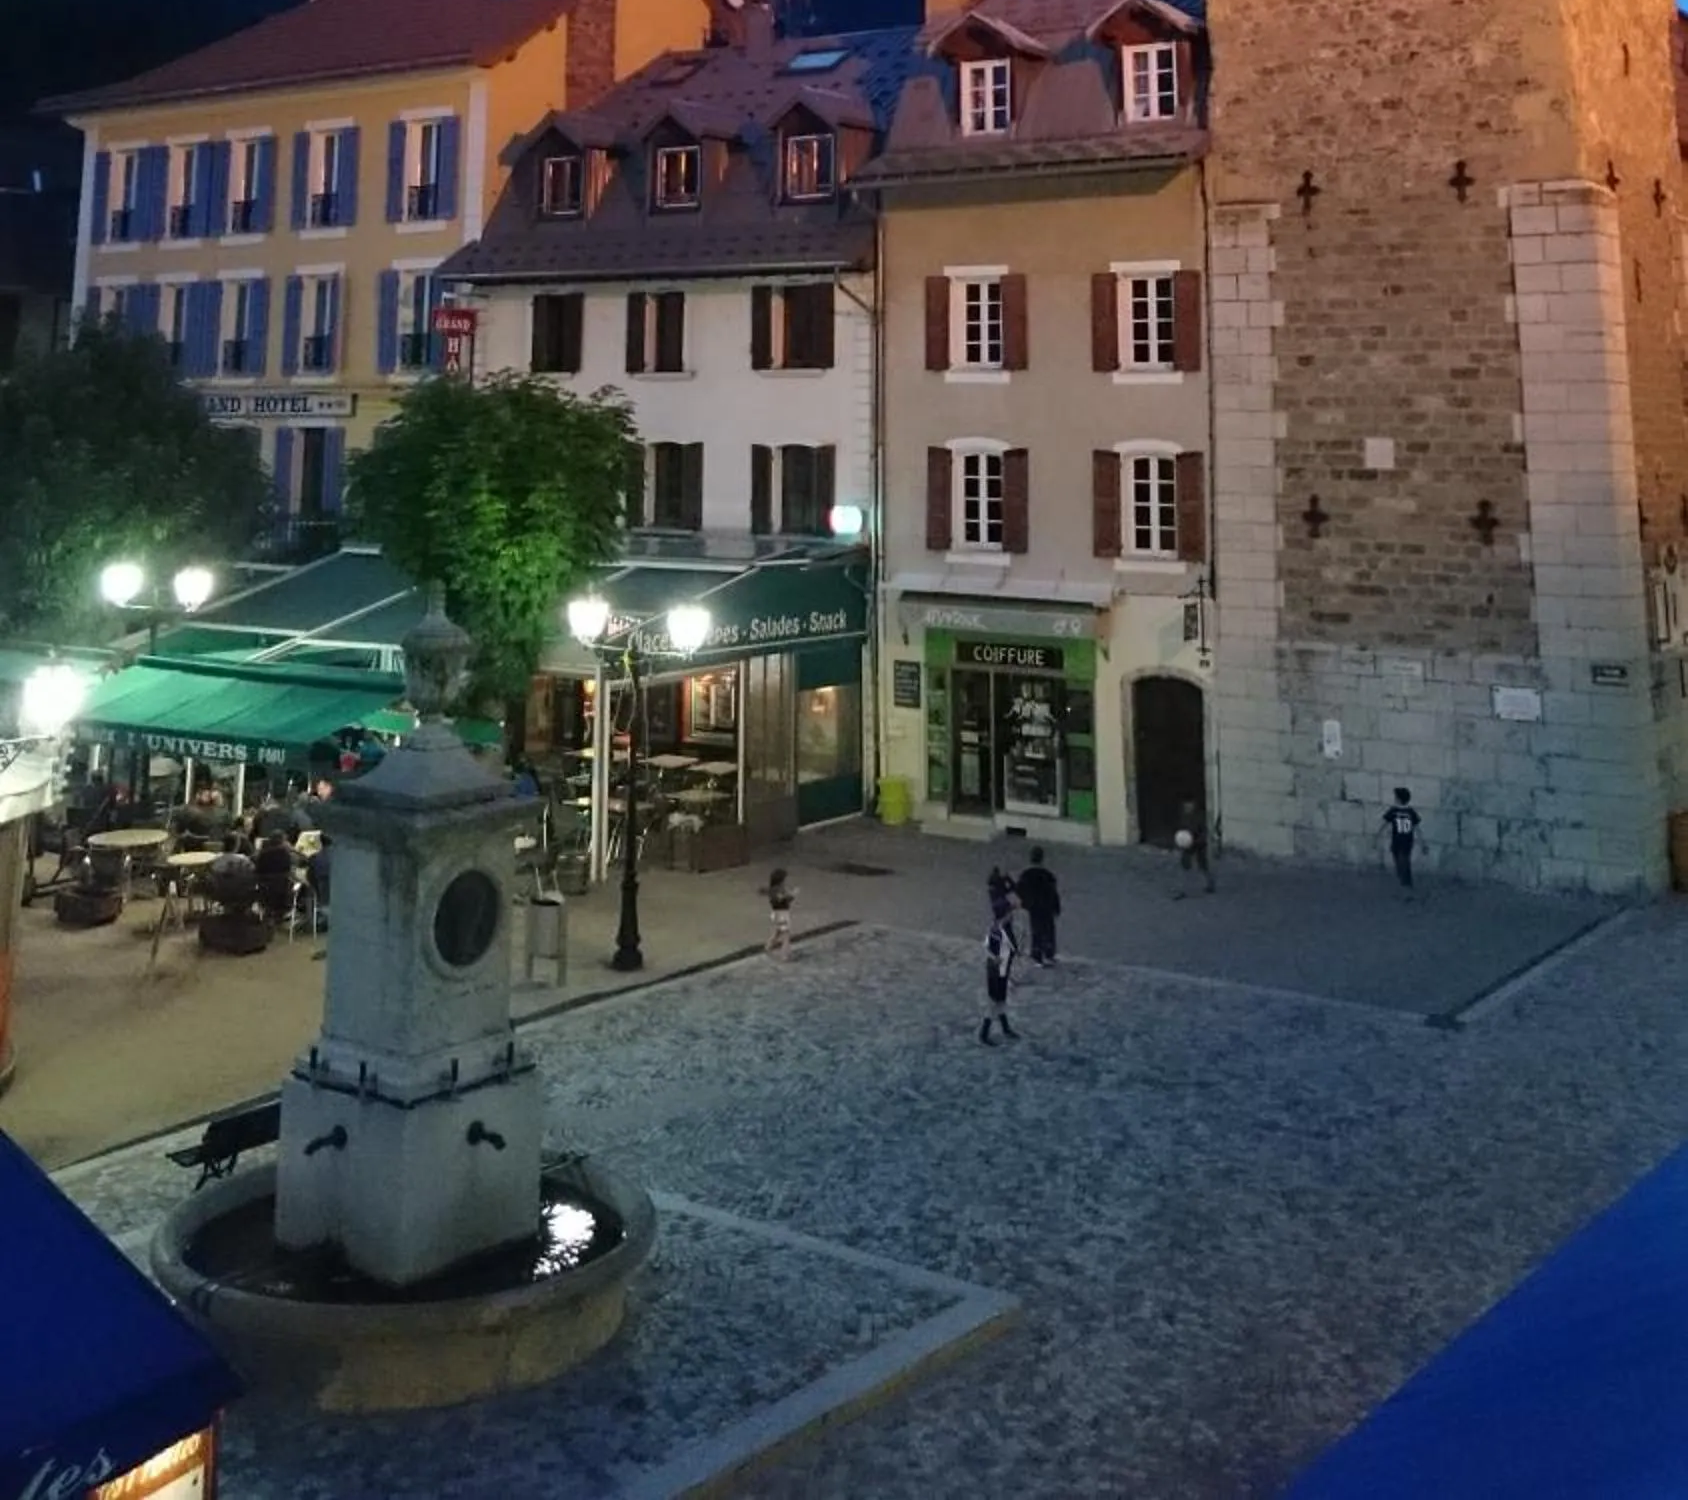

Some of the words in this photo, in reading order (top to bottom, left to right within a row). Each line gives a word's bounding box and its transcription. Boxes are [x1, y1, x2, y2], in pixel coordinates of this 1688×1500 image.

[206, 397, 241, 413] AND
[749, 614, 801, 641] Salades
[809, 607, 847, 633] Snack
[973, 644, 1046, 666] COIFFURE
